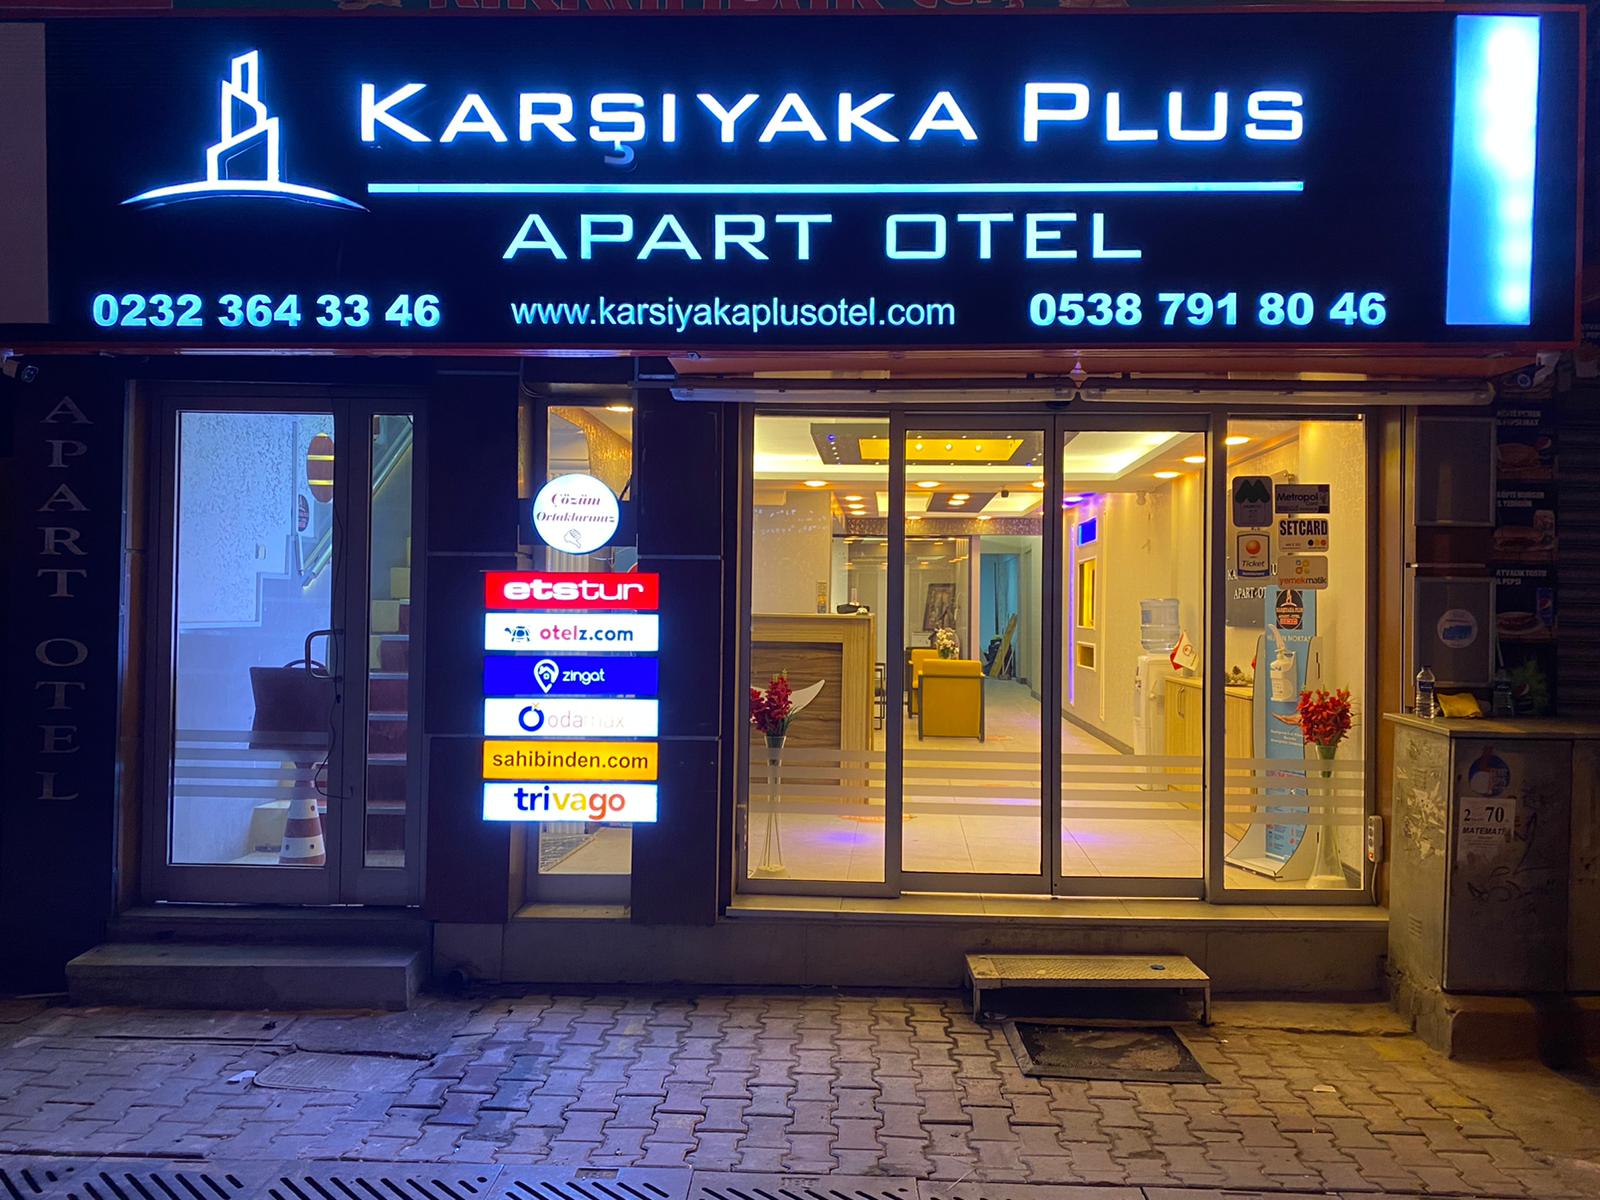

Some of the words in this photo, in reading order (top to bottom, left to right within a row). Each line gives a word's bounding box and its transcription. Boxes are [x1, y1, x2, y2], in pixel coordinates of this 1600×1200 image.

[360, 83, 979, 166] KARŞIYAKA
[1023, 82, 1304, 142] PLUS
[502, 213, 833, 261] APART
[885, 212, 1142, 260] OTEL
[92, 294, 202, 328] 0232
[218, 294, 301, 328] 364
[316, 295, 369, 328] 33
[384, 295, 440, 328] 46
[510, 296, 956, 333] www.karsiyakaplusotel.com
[1029, 292, 1142, 326] 0538
[1158, 292, 1239, 326] 791
[1259, 292, 1314, 326] 80
[1329, 292, 1387, 326] 46
[38, 394, 94, 598] APART
[551, 493, 602, 508] Çözüm
[1277, 492, 1319, 503] Metropol
[1280, 520, 1328, 536] SETCARD
[1241, 559, 1265, 567] Ticket
[503, 578, 644, 601] etstur
[1279, 576, 1327, 586] yemekmatik
[1233, 587, 1255, 600] APART
[539, 624, 634, 642] otelz.com
[562, 668, 606, 685] zingat
[34, 638, 90, 801] OTEL
[492, 750, 649, 769] sahibinden.com
[514, 785, 626, 820] trivago
[1463, 808, 1472, 822] 2
[1485, 806, 1505, 823] 70
